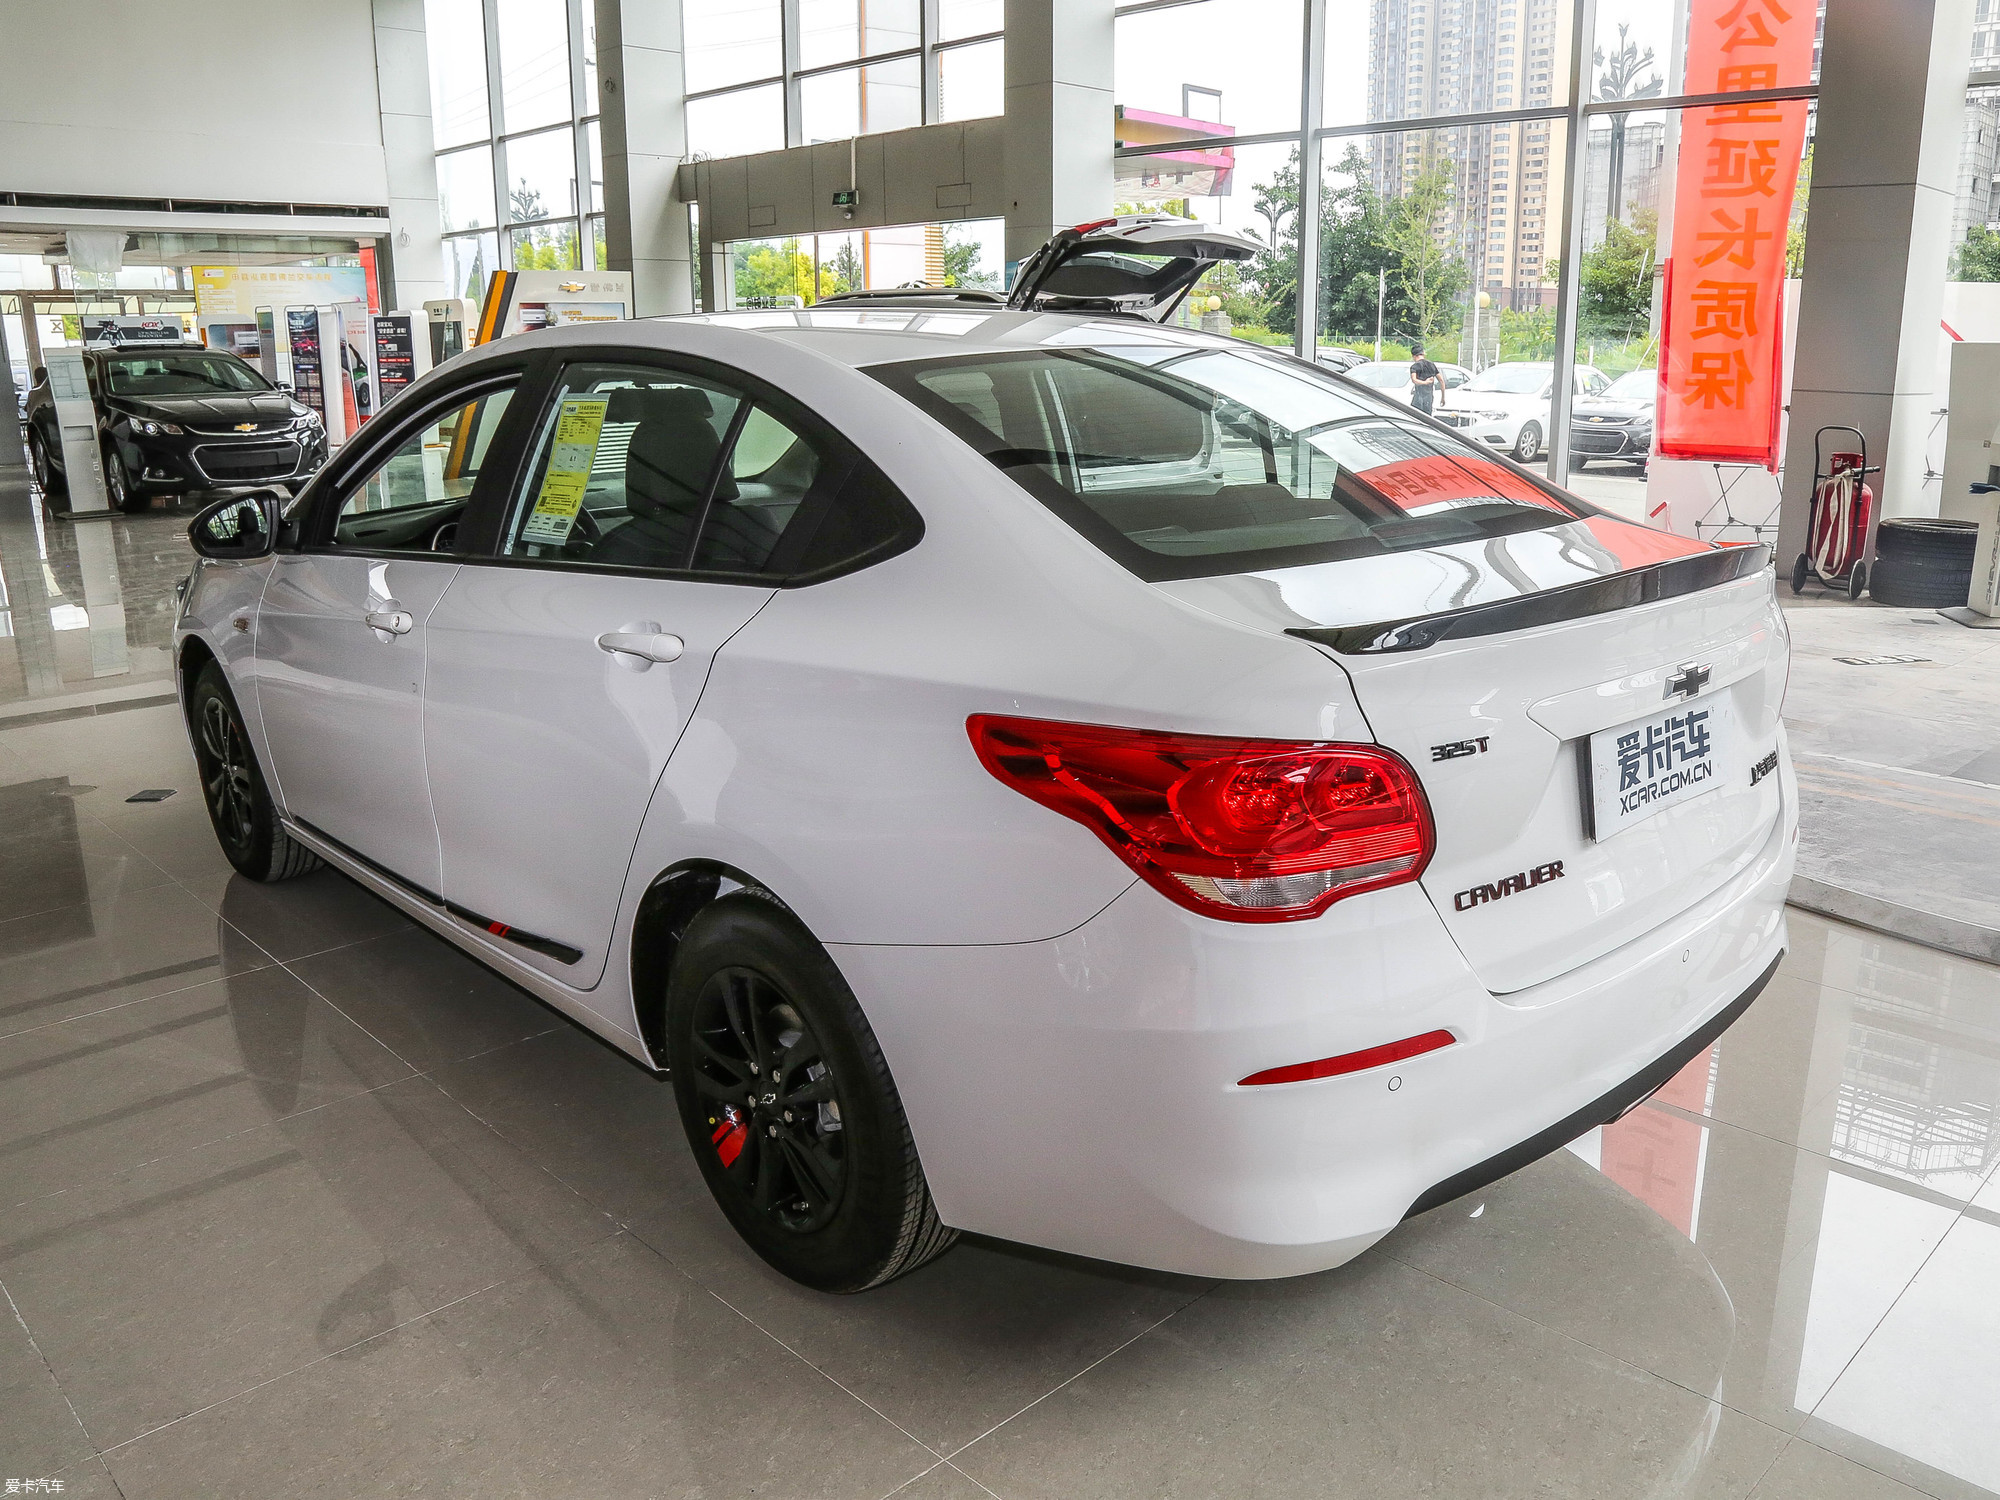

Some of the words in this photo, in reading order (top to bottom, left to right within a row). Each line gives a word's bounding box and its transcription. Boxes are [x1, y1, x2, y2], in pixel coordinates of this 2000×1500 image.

[1430, 735, 1490, 762] 325T
[1617, 711, 1711, 792] 爱卡汽车
[1620, 759, 1712, 816] XCAR.COM.CN
[1454, 859, 1566, 912] CAVALIER
